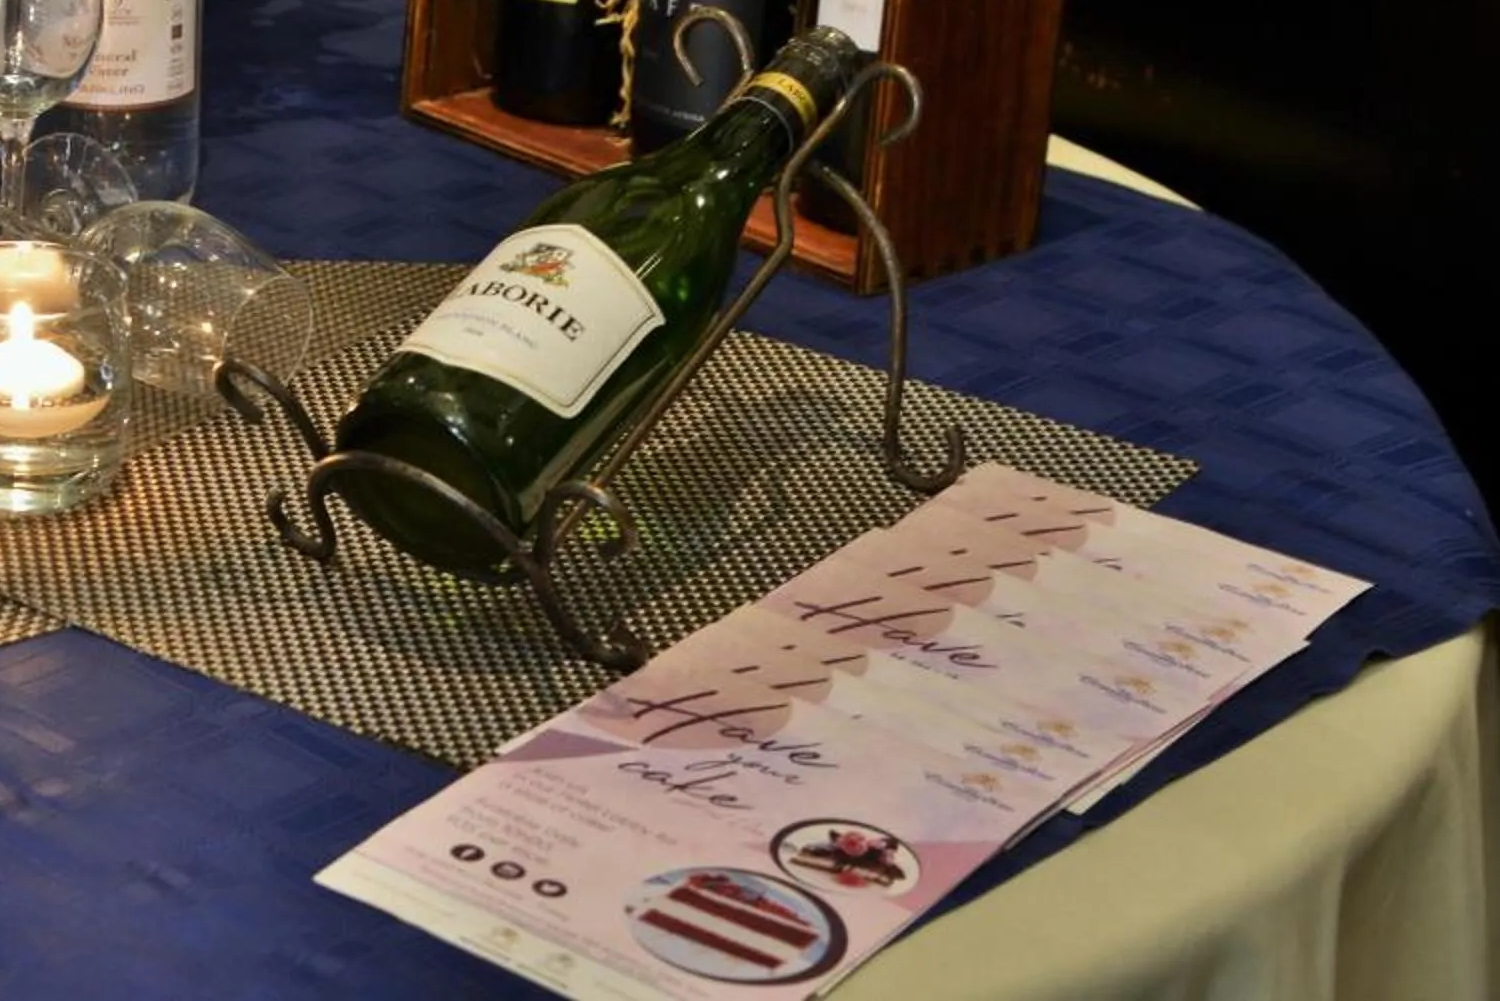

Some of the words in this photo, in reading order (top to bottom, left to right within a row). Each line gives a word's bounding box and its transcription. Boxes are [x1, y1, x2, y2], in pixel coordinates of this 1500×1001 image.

[456, 280, 587, 342] ABORIE
[625, 690, 839, 768] Have
[618, 761, 754, 810] cake
